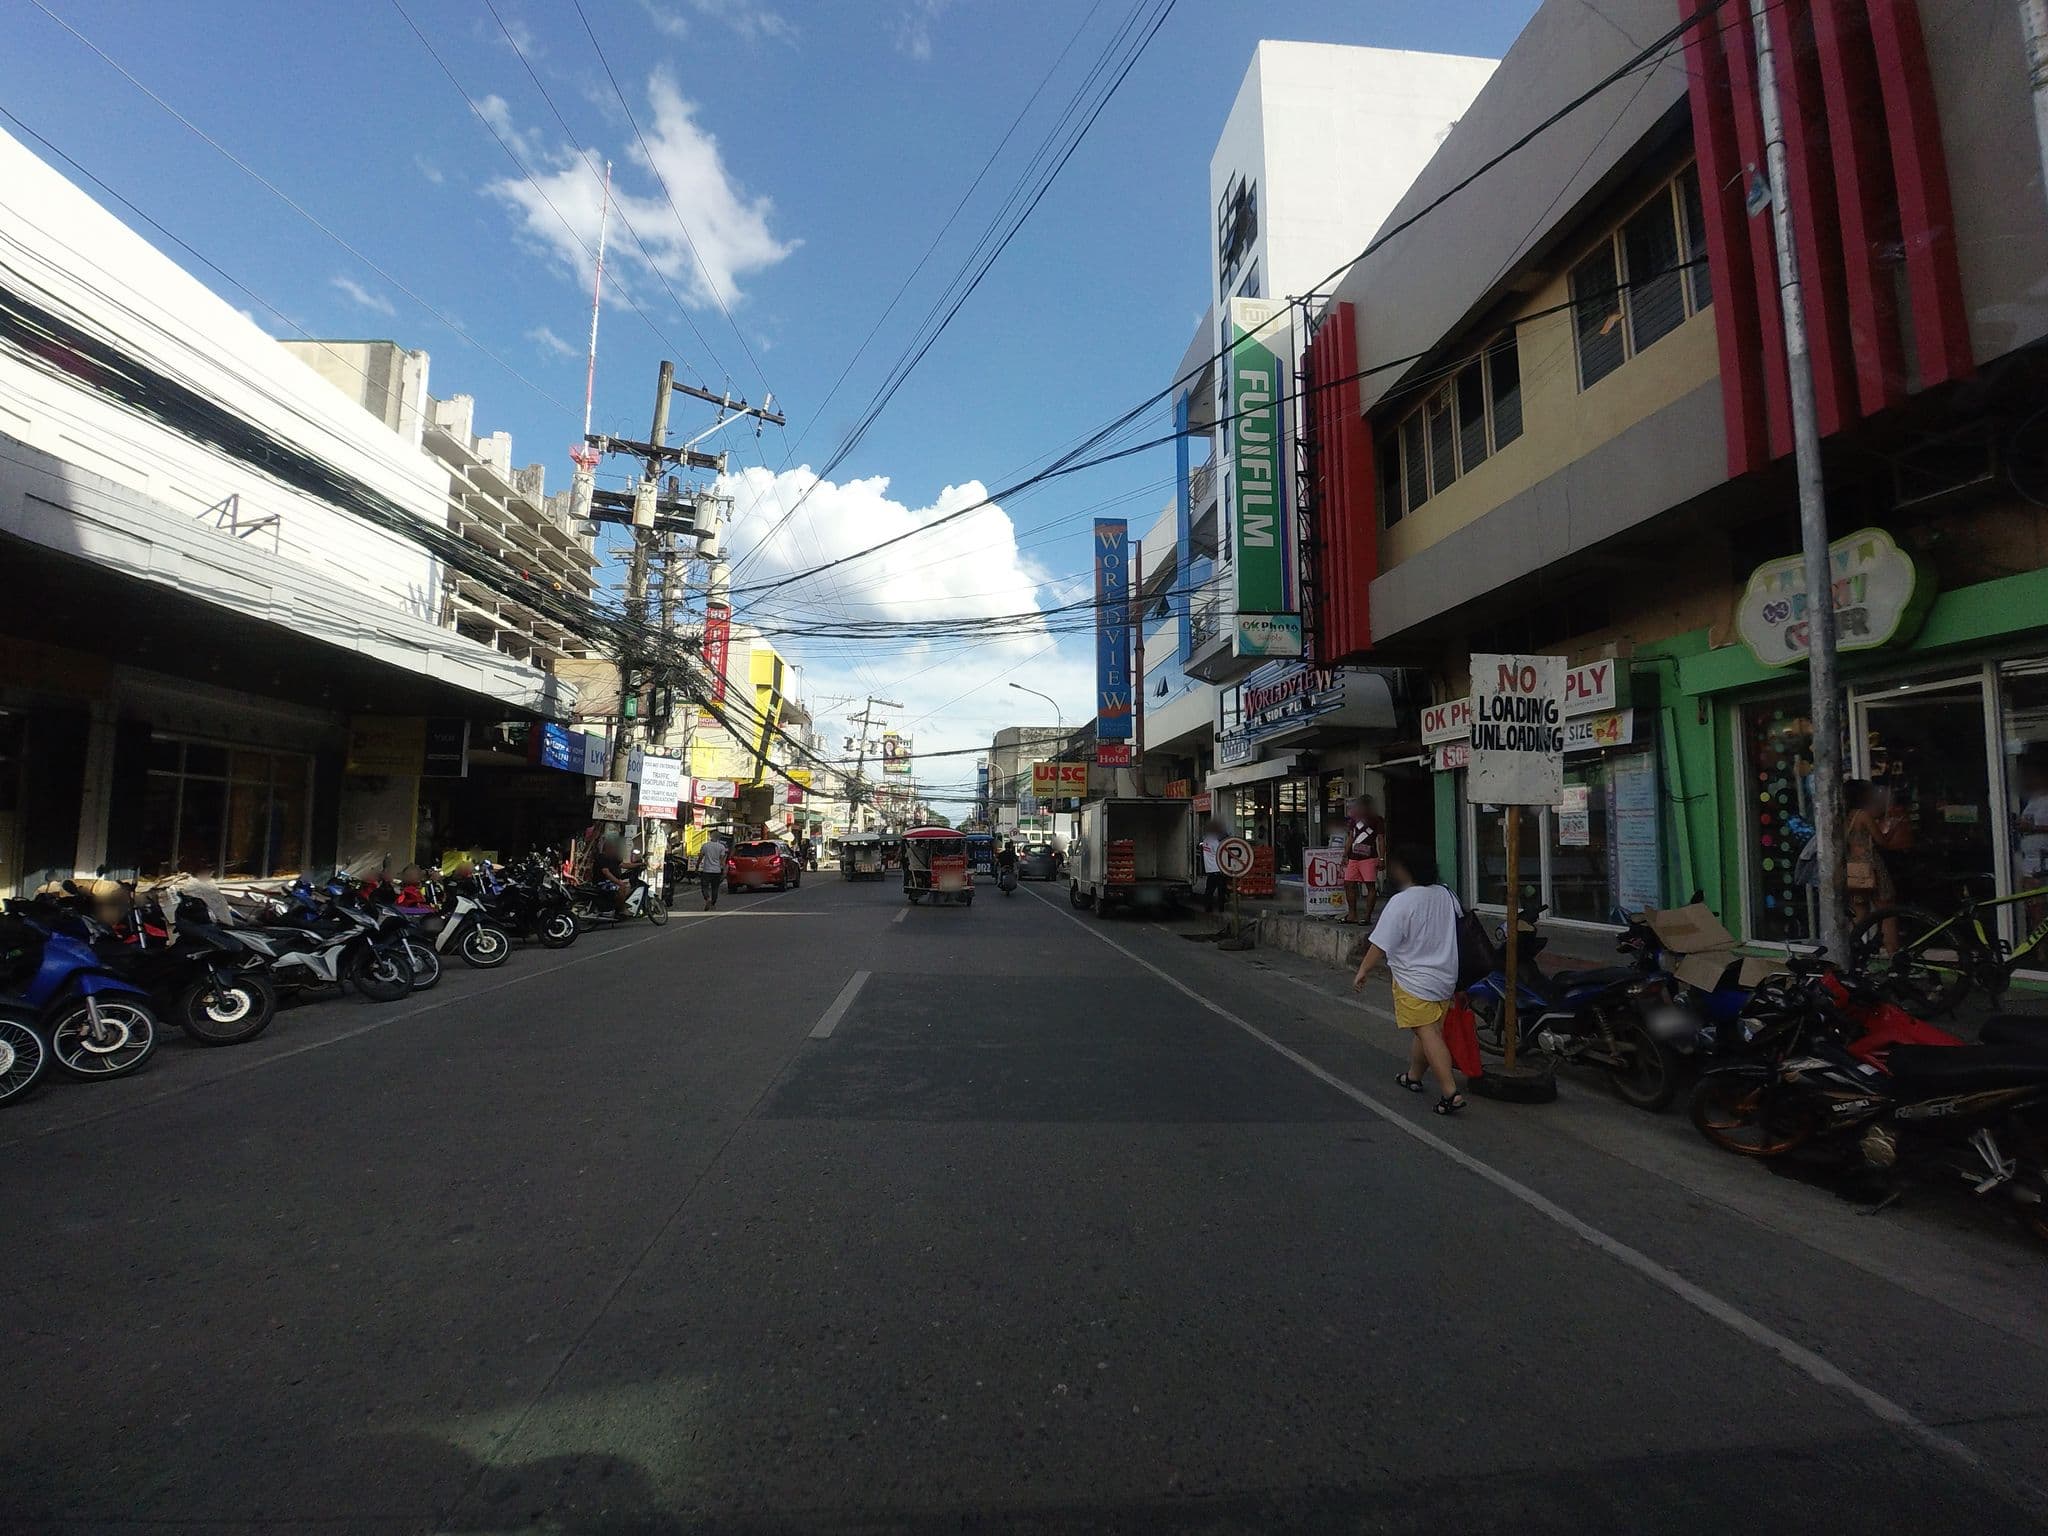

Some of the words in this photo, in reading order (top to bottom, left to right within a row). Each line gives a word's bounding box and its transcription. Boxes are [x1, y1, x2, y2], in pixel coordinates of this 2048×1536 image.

[1238, 369, 1275, 548] FUJIFILM
[1498, 664, 1537, 692] NO
[1244, 668, 1334, 720] WORLDVIEW
[1425, 708, 1446, 732] OK
[1479, 696, 1558, 724] LOADING
[1471, 724, 1564, 753] UNLOADING
[1569, 722, 1593, 741] SIZE
[1099, 754, 1129, 763] Hotel
[1035, 766, 1085, 781] USSC
[1227, 847, 1242, 867] P
[1832, 1099, 1870, 1112] SUKI
[1895, 1103, 1955, 1119] RAER
